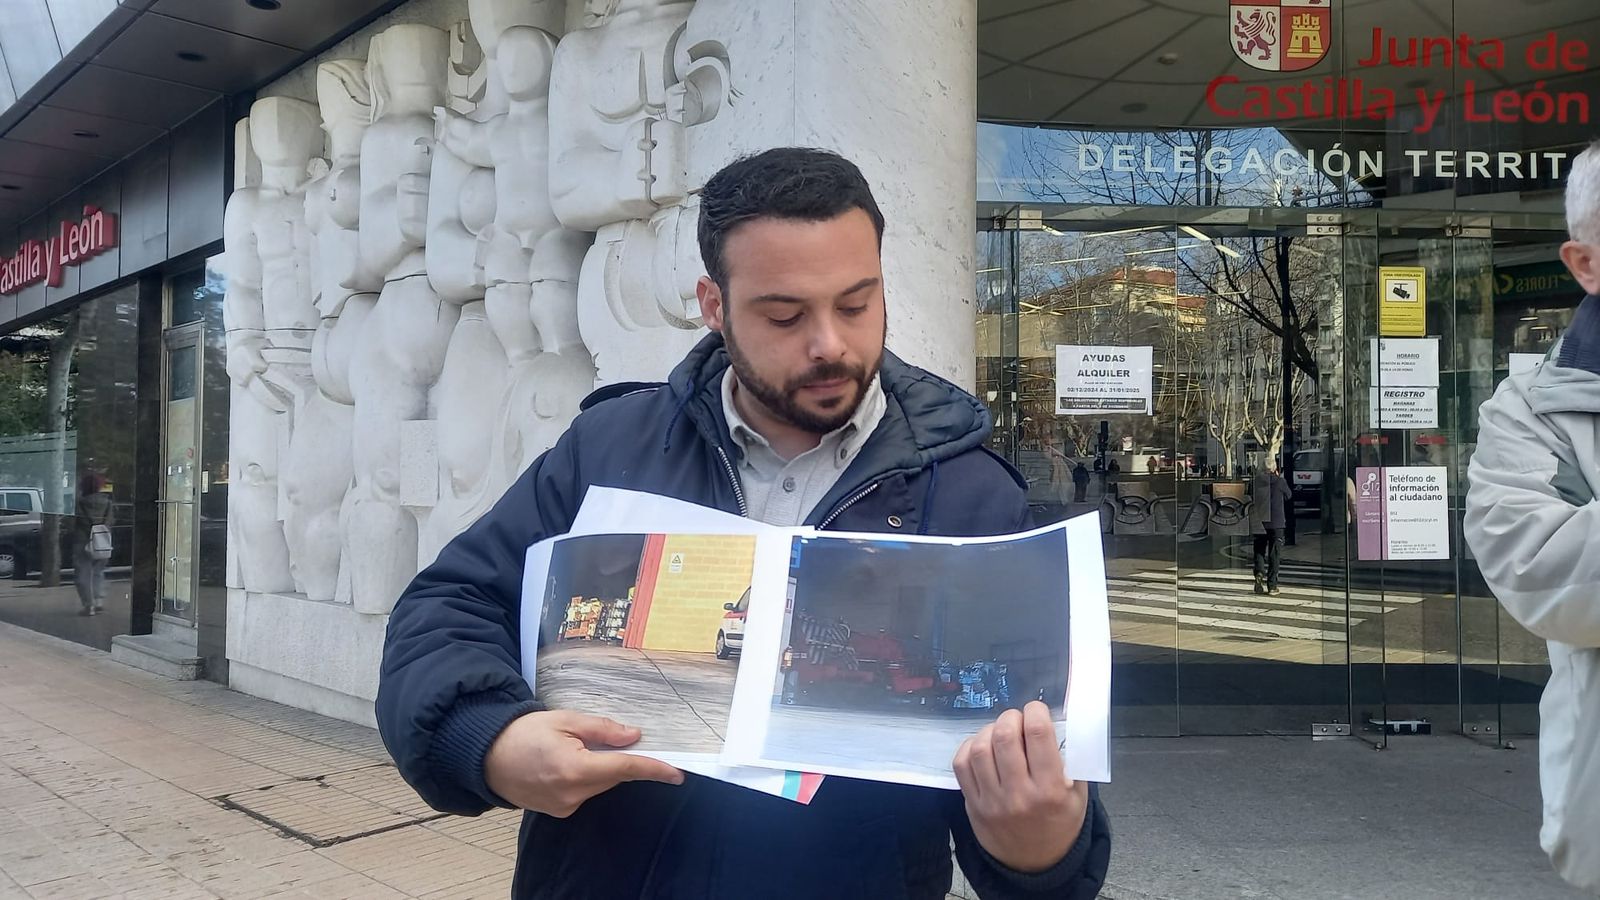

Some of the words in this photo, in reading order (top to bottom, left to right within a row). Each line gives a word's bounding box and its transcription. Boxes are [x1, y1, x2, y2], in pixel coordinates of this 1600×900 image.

[1358, 27, 1504, 70] Junta
[1525, 32, 1589, 72] de
[1206, 75, 1395, 120] Castilla
[1415, 88, 1445, 134] y
[1464, 79, 1589, 124] León
[1078, 143, 1384, 178] DELEGACIÓN
[1405, 149, 1567, 180] TERRIT
[0, 240, 40, 293] astilla
[44, 237, 55, 287] y
[60, 205, 104, 265] León
[1082, 354, 1126, 362] AYUDAS
[1077, 369, 1131, 377] ALQUILER
[1389, 474, 1424, 483] Teléfono
[1425, 474, 1436, 483] de
[1389, 483, 1440, 492] información
[1389, 493, 1397, 501] al
[1399, 493, 1443, 501] ciudadano
